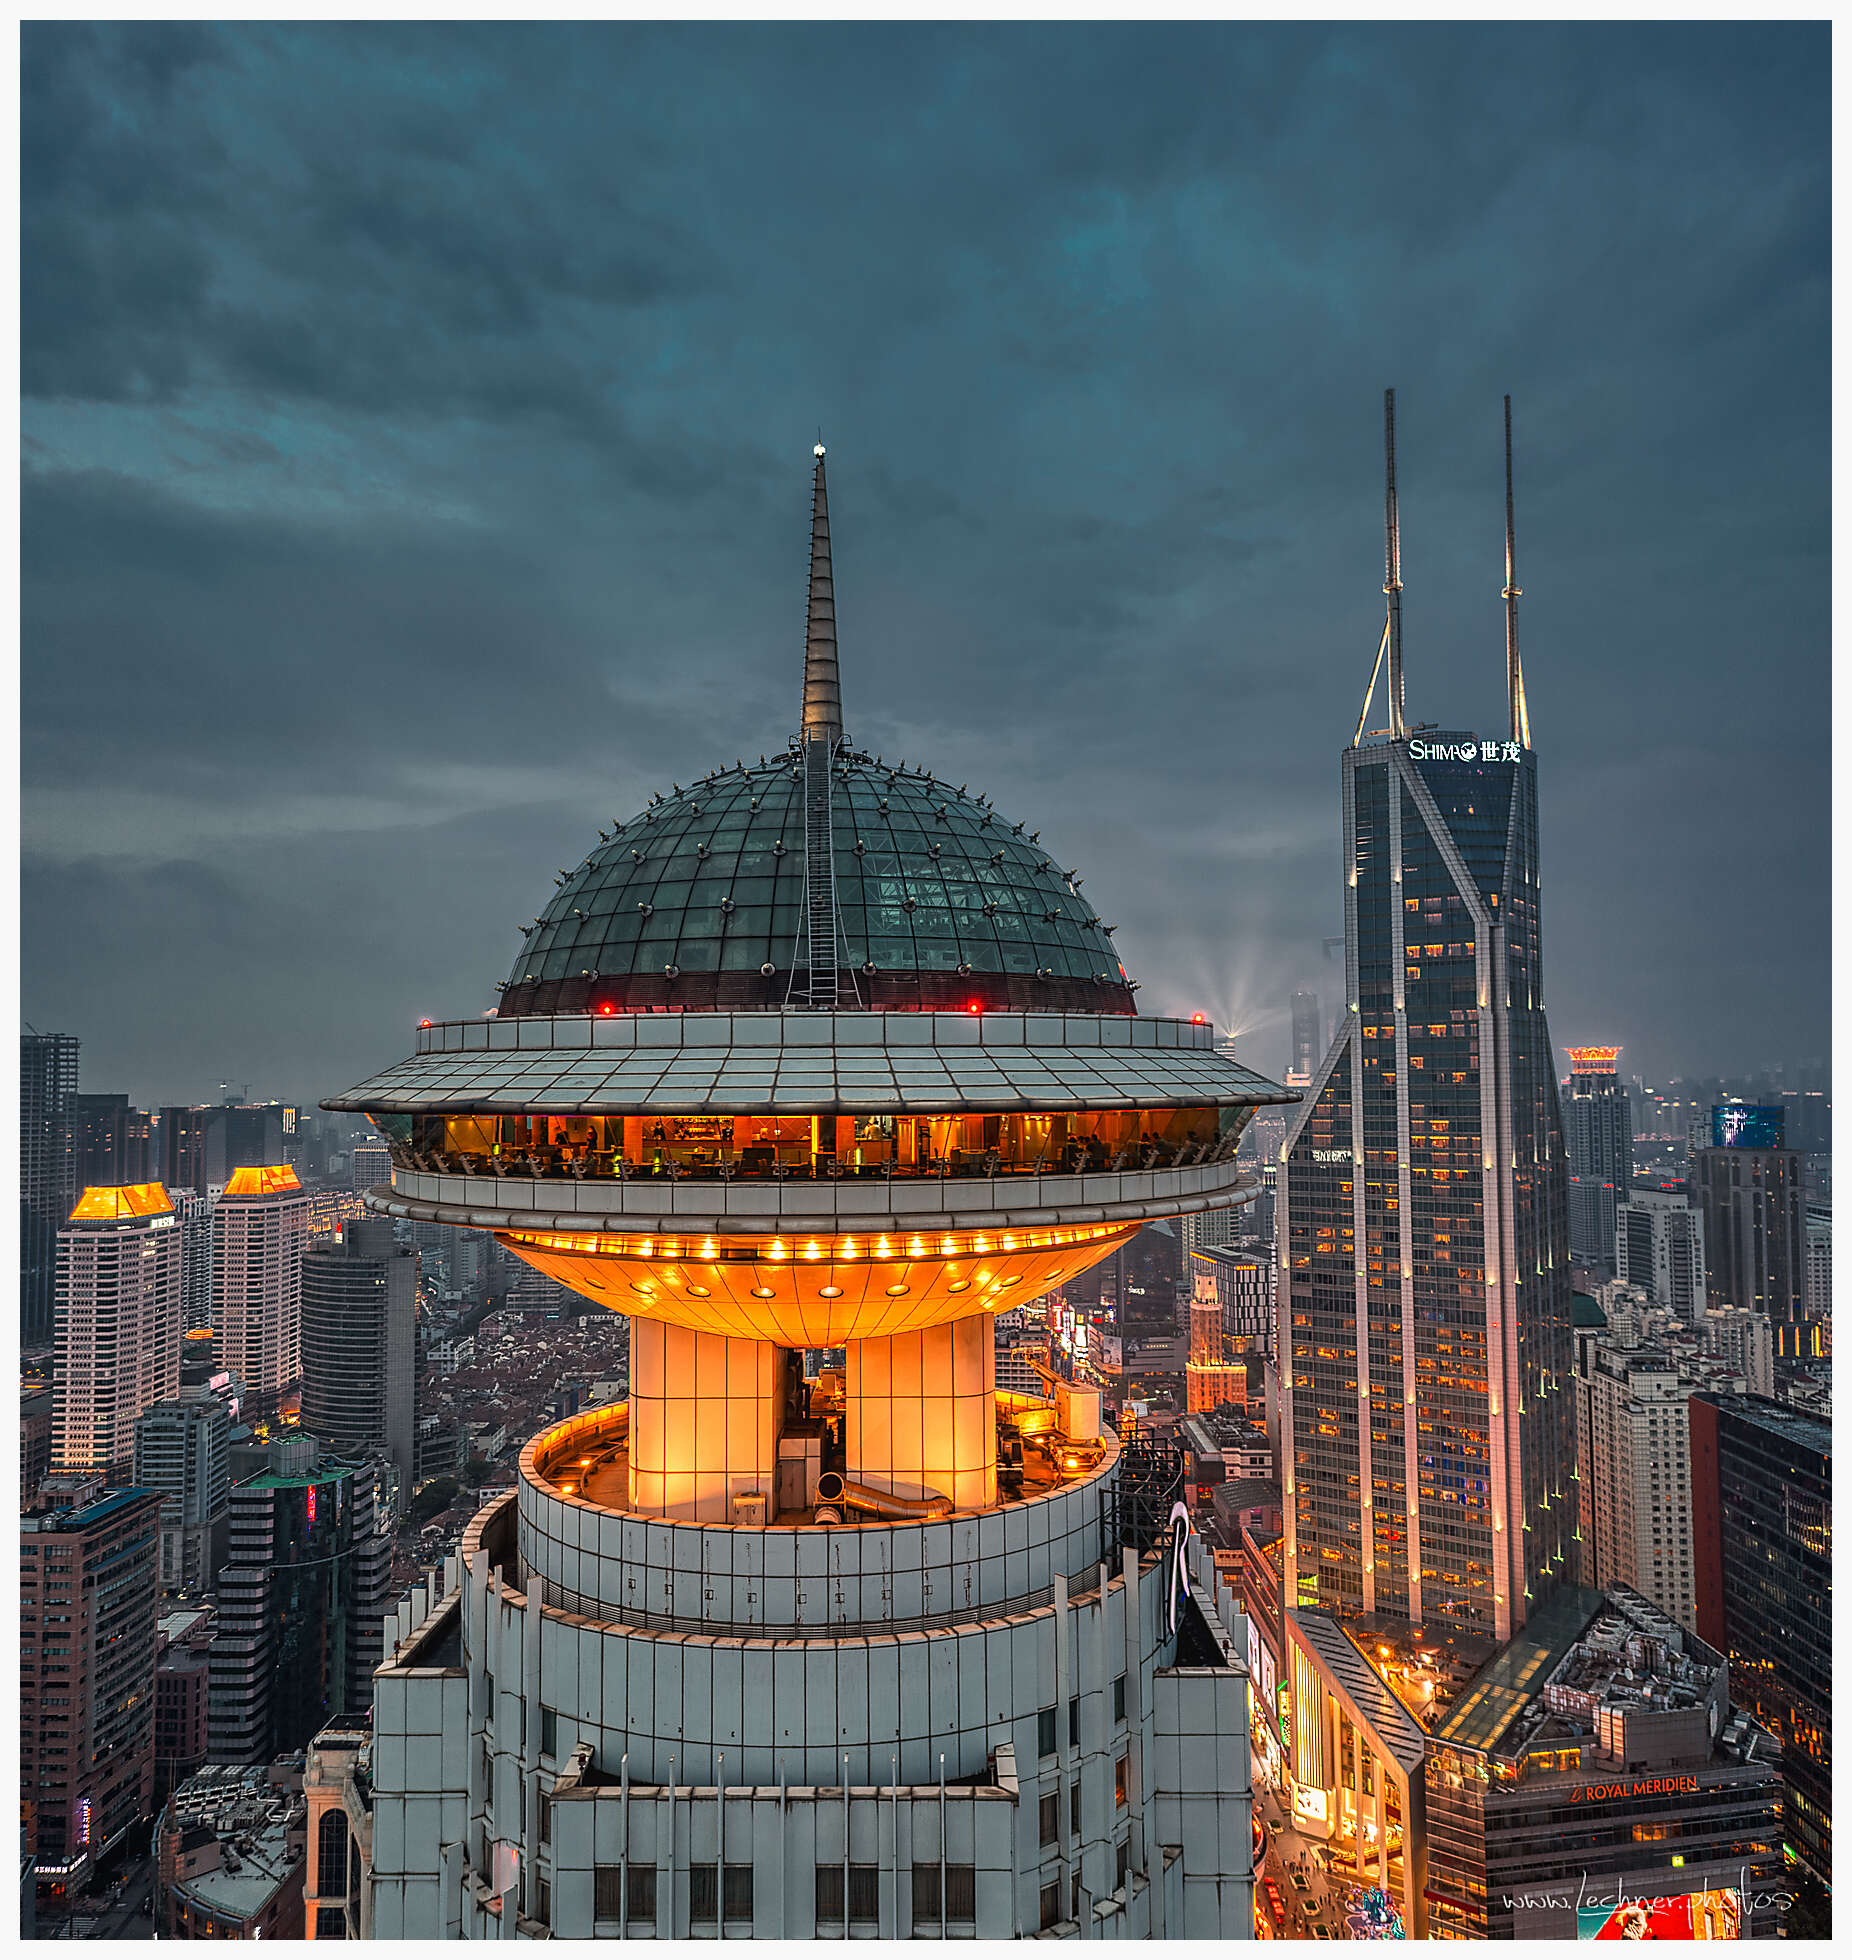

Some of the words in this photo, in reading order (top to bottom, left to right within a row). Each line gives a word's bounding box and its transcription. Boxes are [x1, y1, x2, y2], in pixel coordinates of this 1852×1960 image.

[1480, 741, 1521, 763] 世茂
[1586, 1783, 1631, 1801] ROYAL
[1632, 1775, 1697, 1796] MERIDIEN
